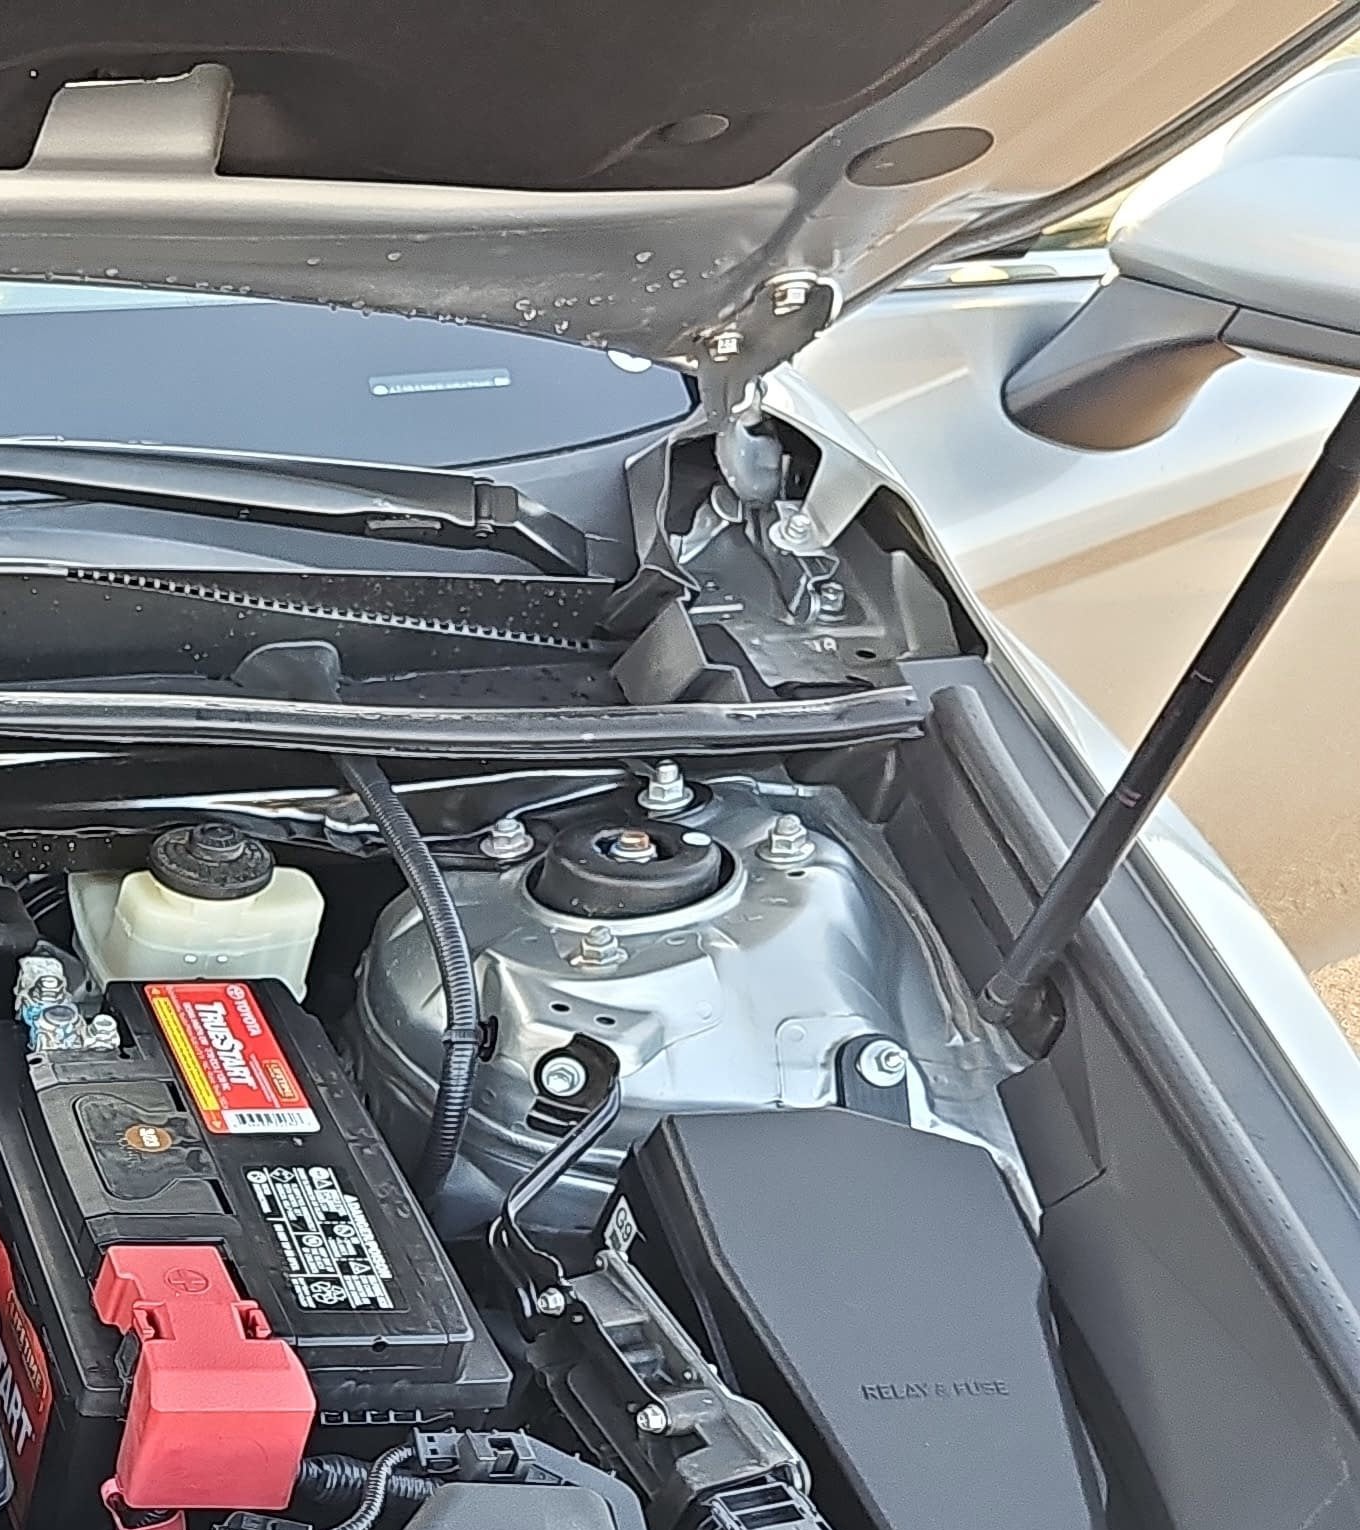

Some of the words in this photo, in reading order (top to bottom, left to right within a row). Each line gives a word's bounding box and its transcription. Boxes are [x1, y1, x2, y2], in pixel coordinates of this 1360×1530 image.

[234, 999, 263, 1037] TOYOTA
[860, 1382, 929, 1402] RELAY
[935, 1383, 950, 1398] &
[952, 1379, 1010, 1398] FUSE
